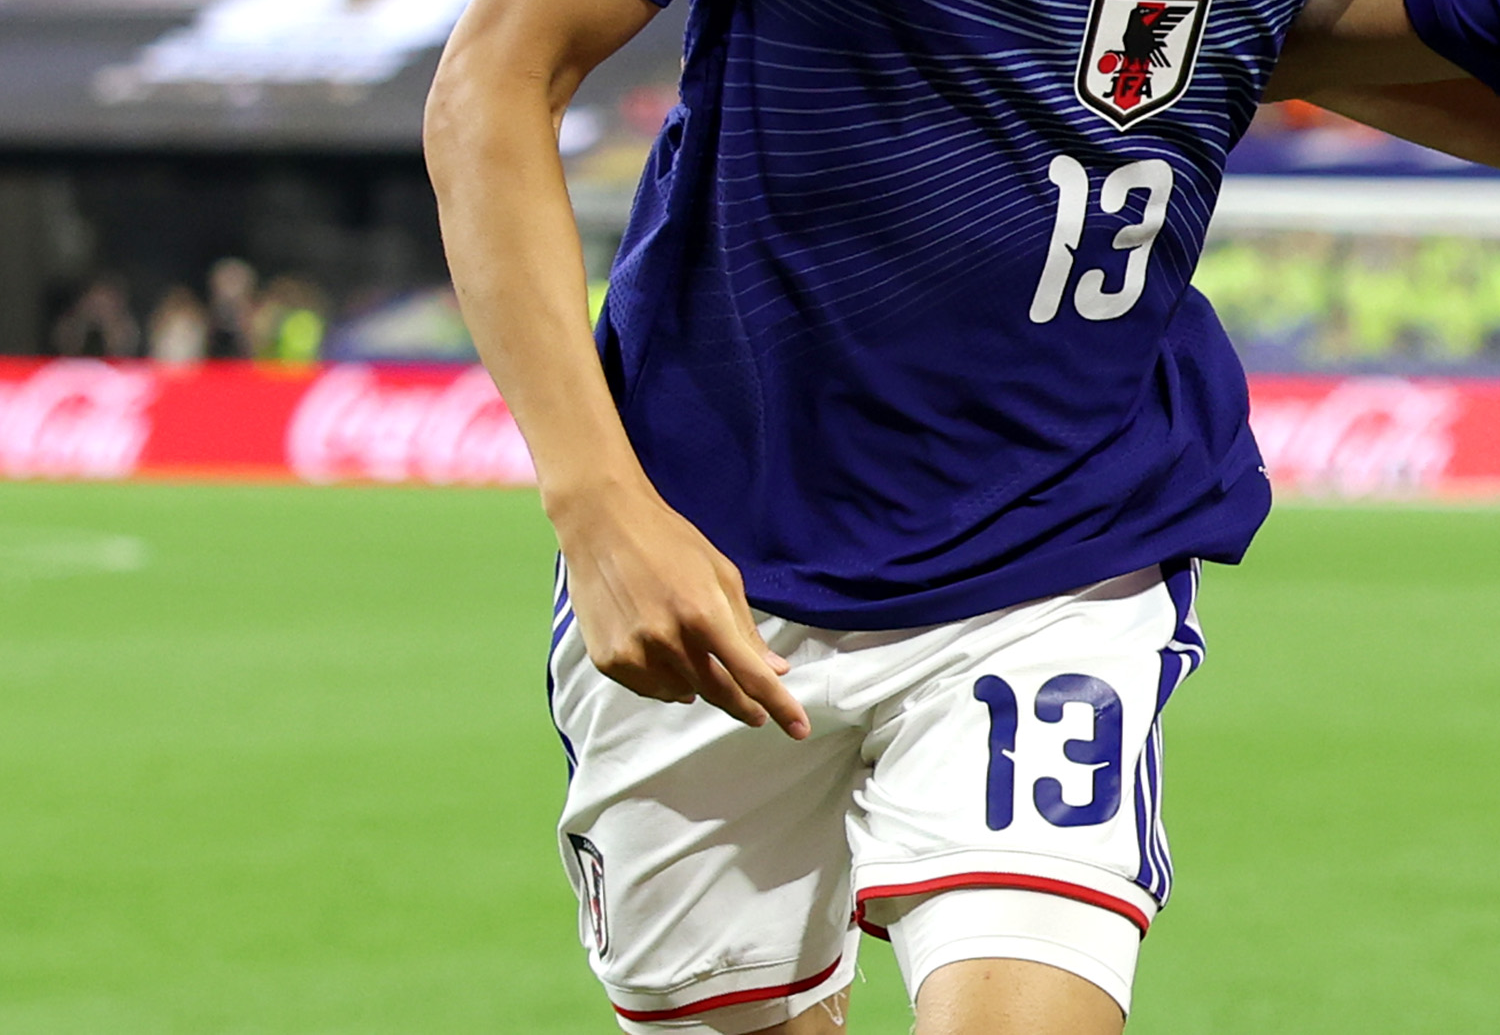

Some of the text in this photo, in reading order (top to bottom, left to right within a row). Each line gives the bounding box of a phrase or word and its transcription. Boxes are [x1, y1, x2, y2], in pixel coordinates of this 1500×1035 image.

[1102, 75, 1153, 99] JFA
[1029, 154, 1174, 324] 13
[973, 673, 1123, 831] 13
